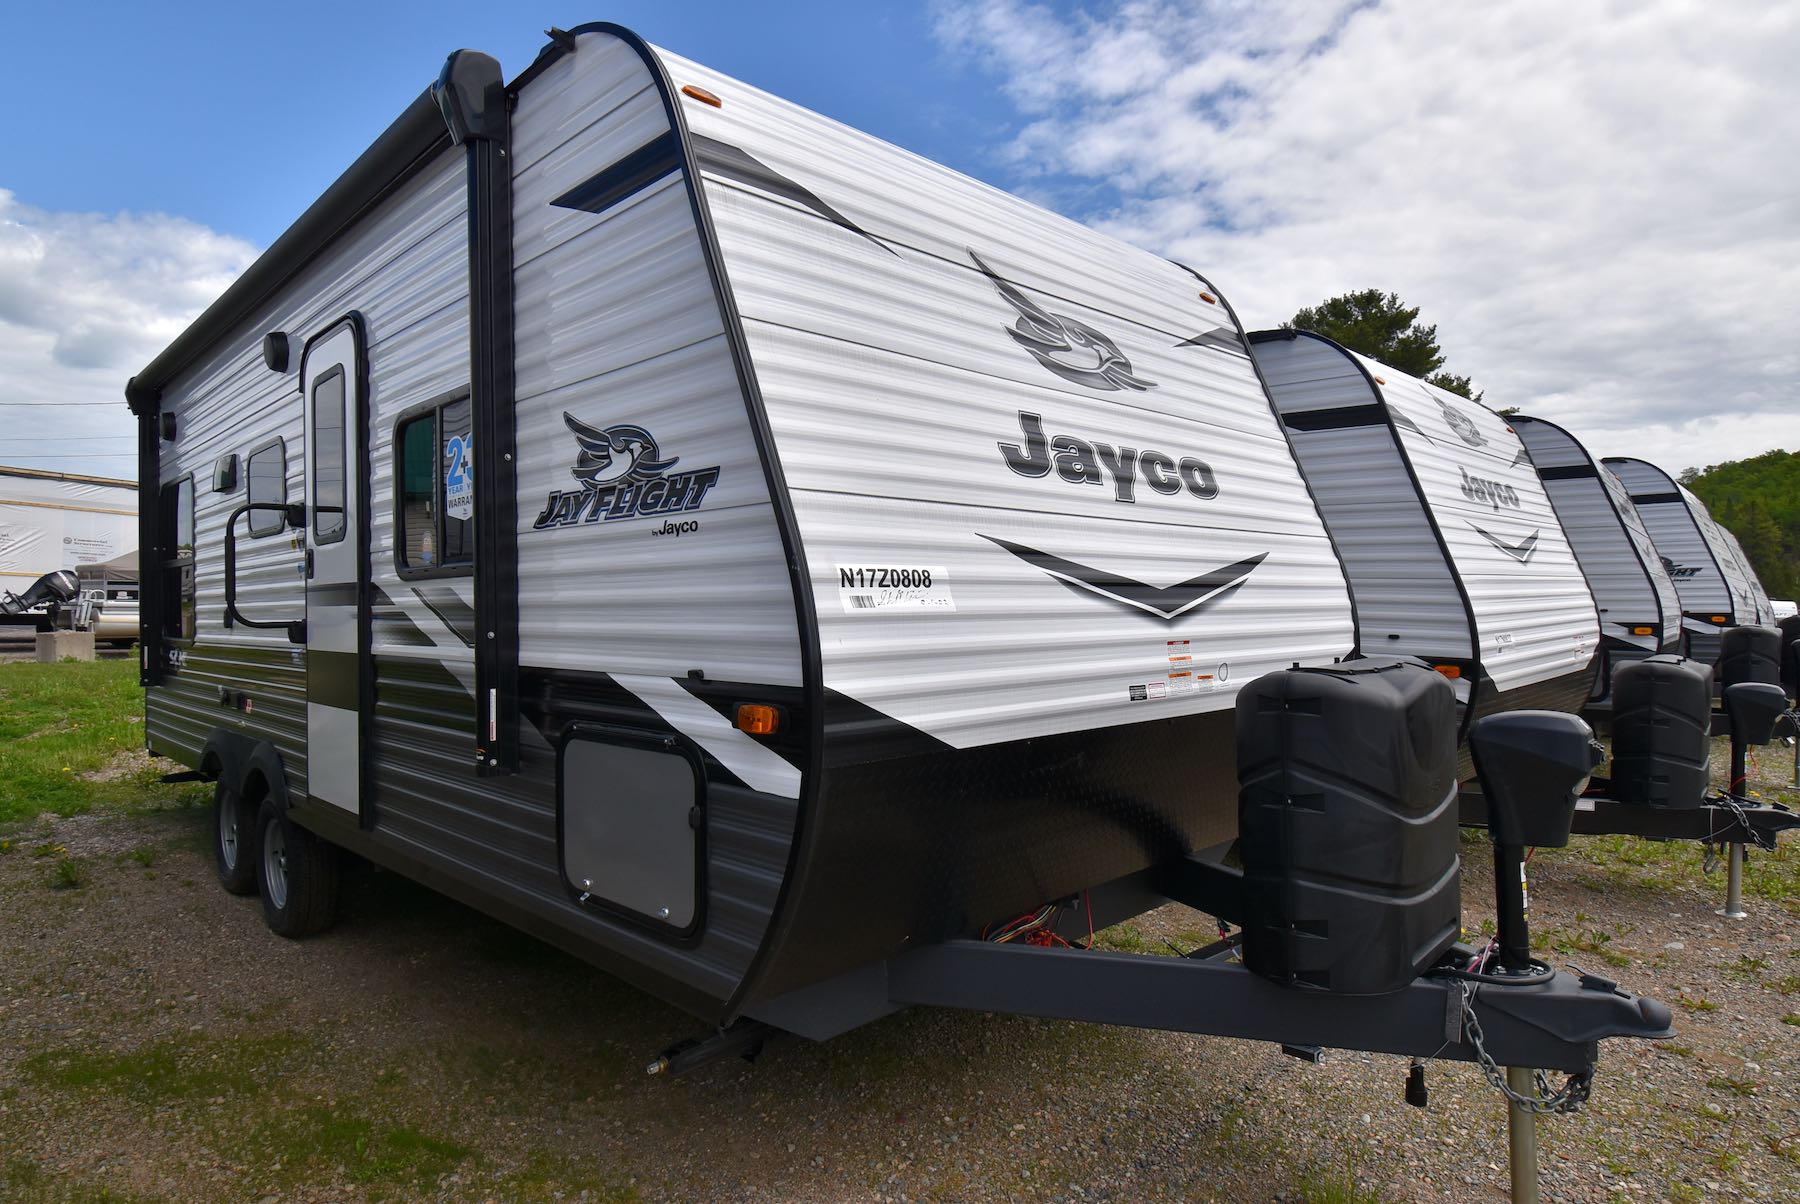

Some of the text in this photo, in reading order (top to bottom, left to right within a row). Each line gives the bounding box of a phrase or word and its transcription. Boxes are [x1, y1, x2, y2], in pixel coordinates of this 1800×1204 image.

[997, 410, 1220, 503] Jayco
[1457, 465, 1520, 512] Jayco
[659, 519, 699, 537] Jayco
[840, 567, 932, 588] N17Z0808
